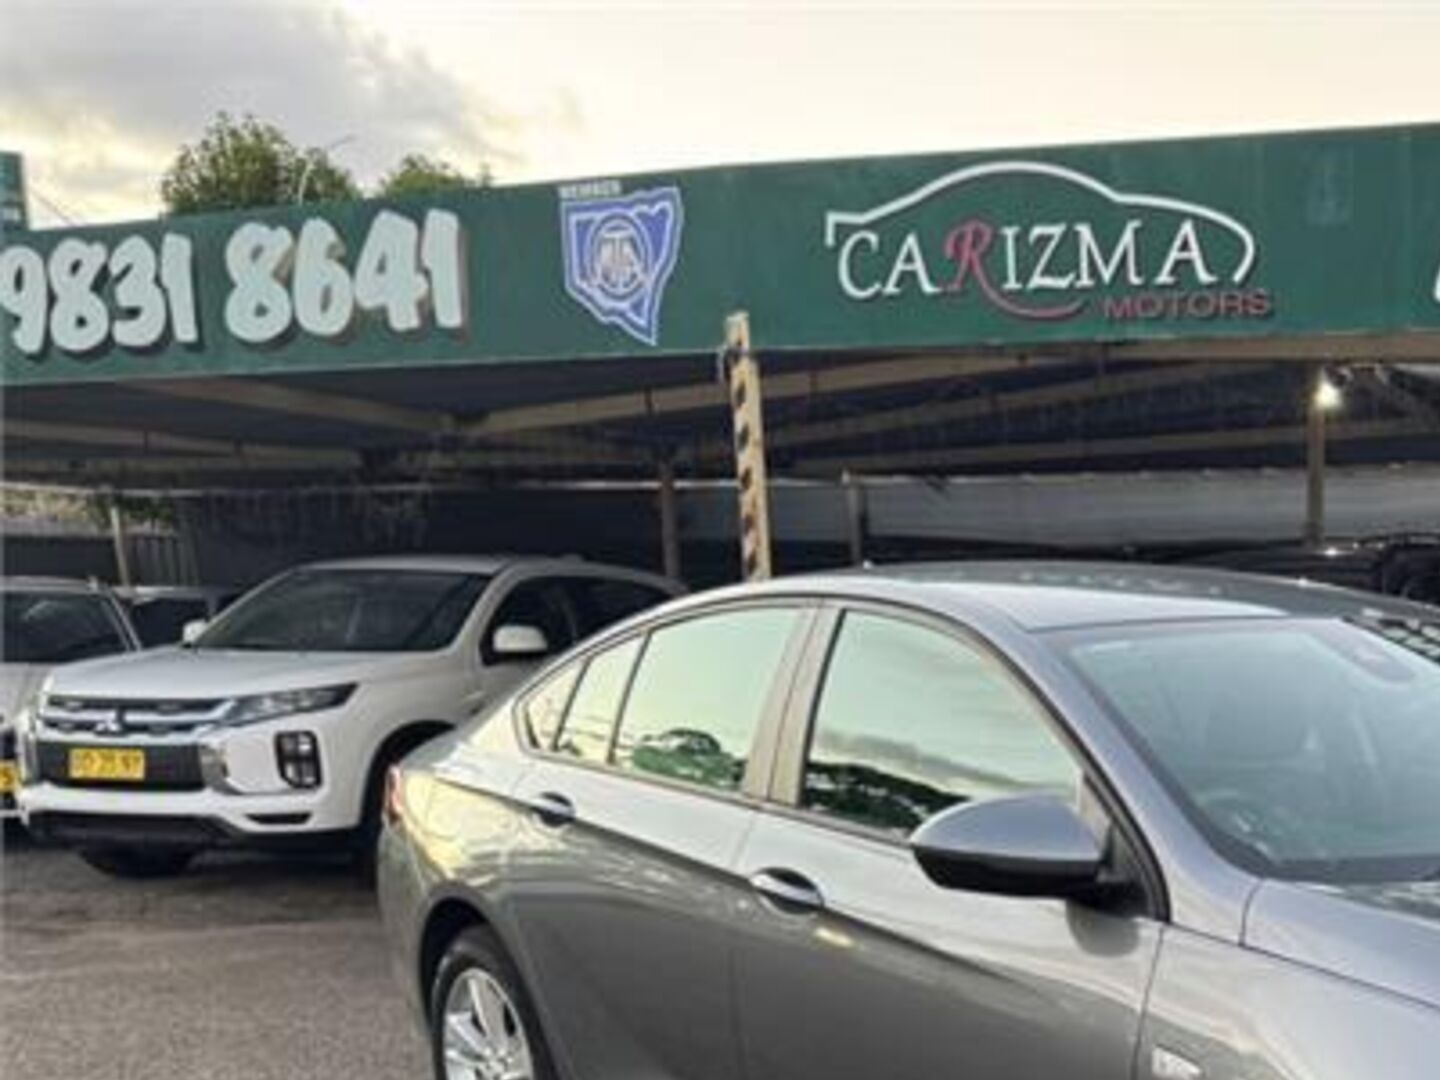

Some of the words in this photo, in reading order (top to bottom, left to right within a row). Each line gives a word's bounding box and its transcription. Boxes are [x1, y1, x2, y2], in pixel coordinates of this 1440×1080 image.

[2, 236, 200, 355] 9831
[223, 207, 466, 344] 8641
[838, 218, 1218, 318] CARIZMA
[1103, 287, 1271, 322] MOTORS
